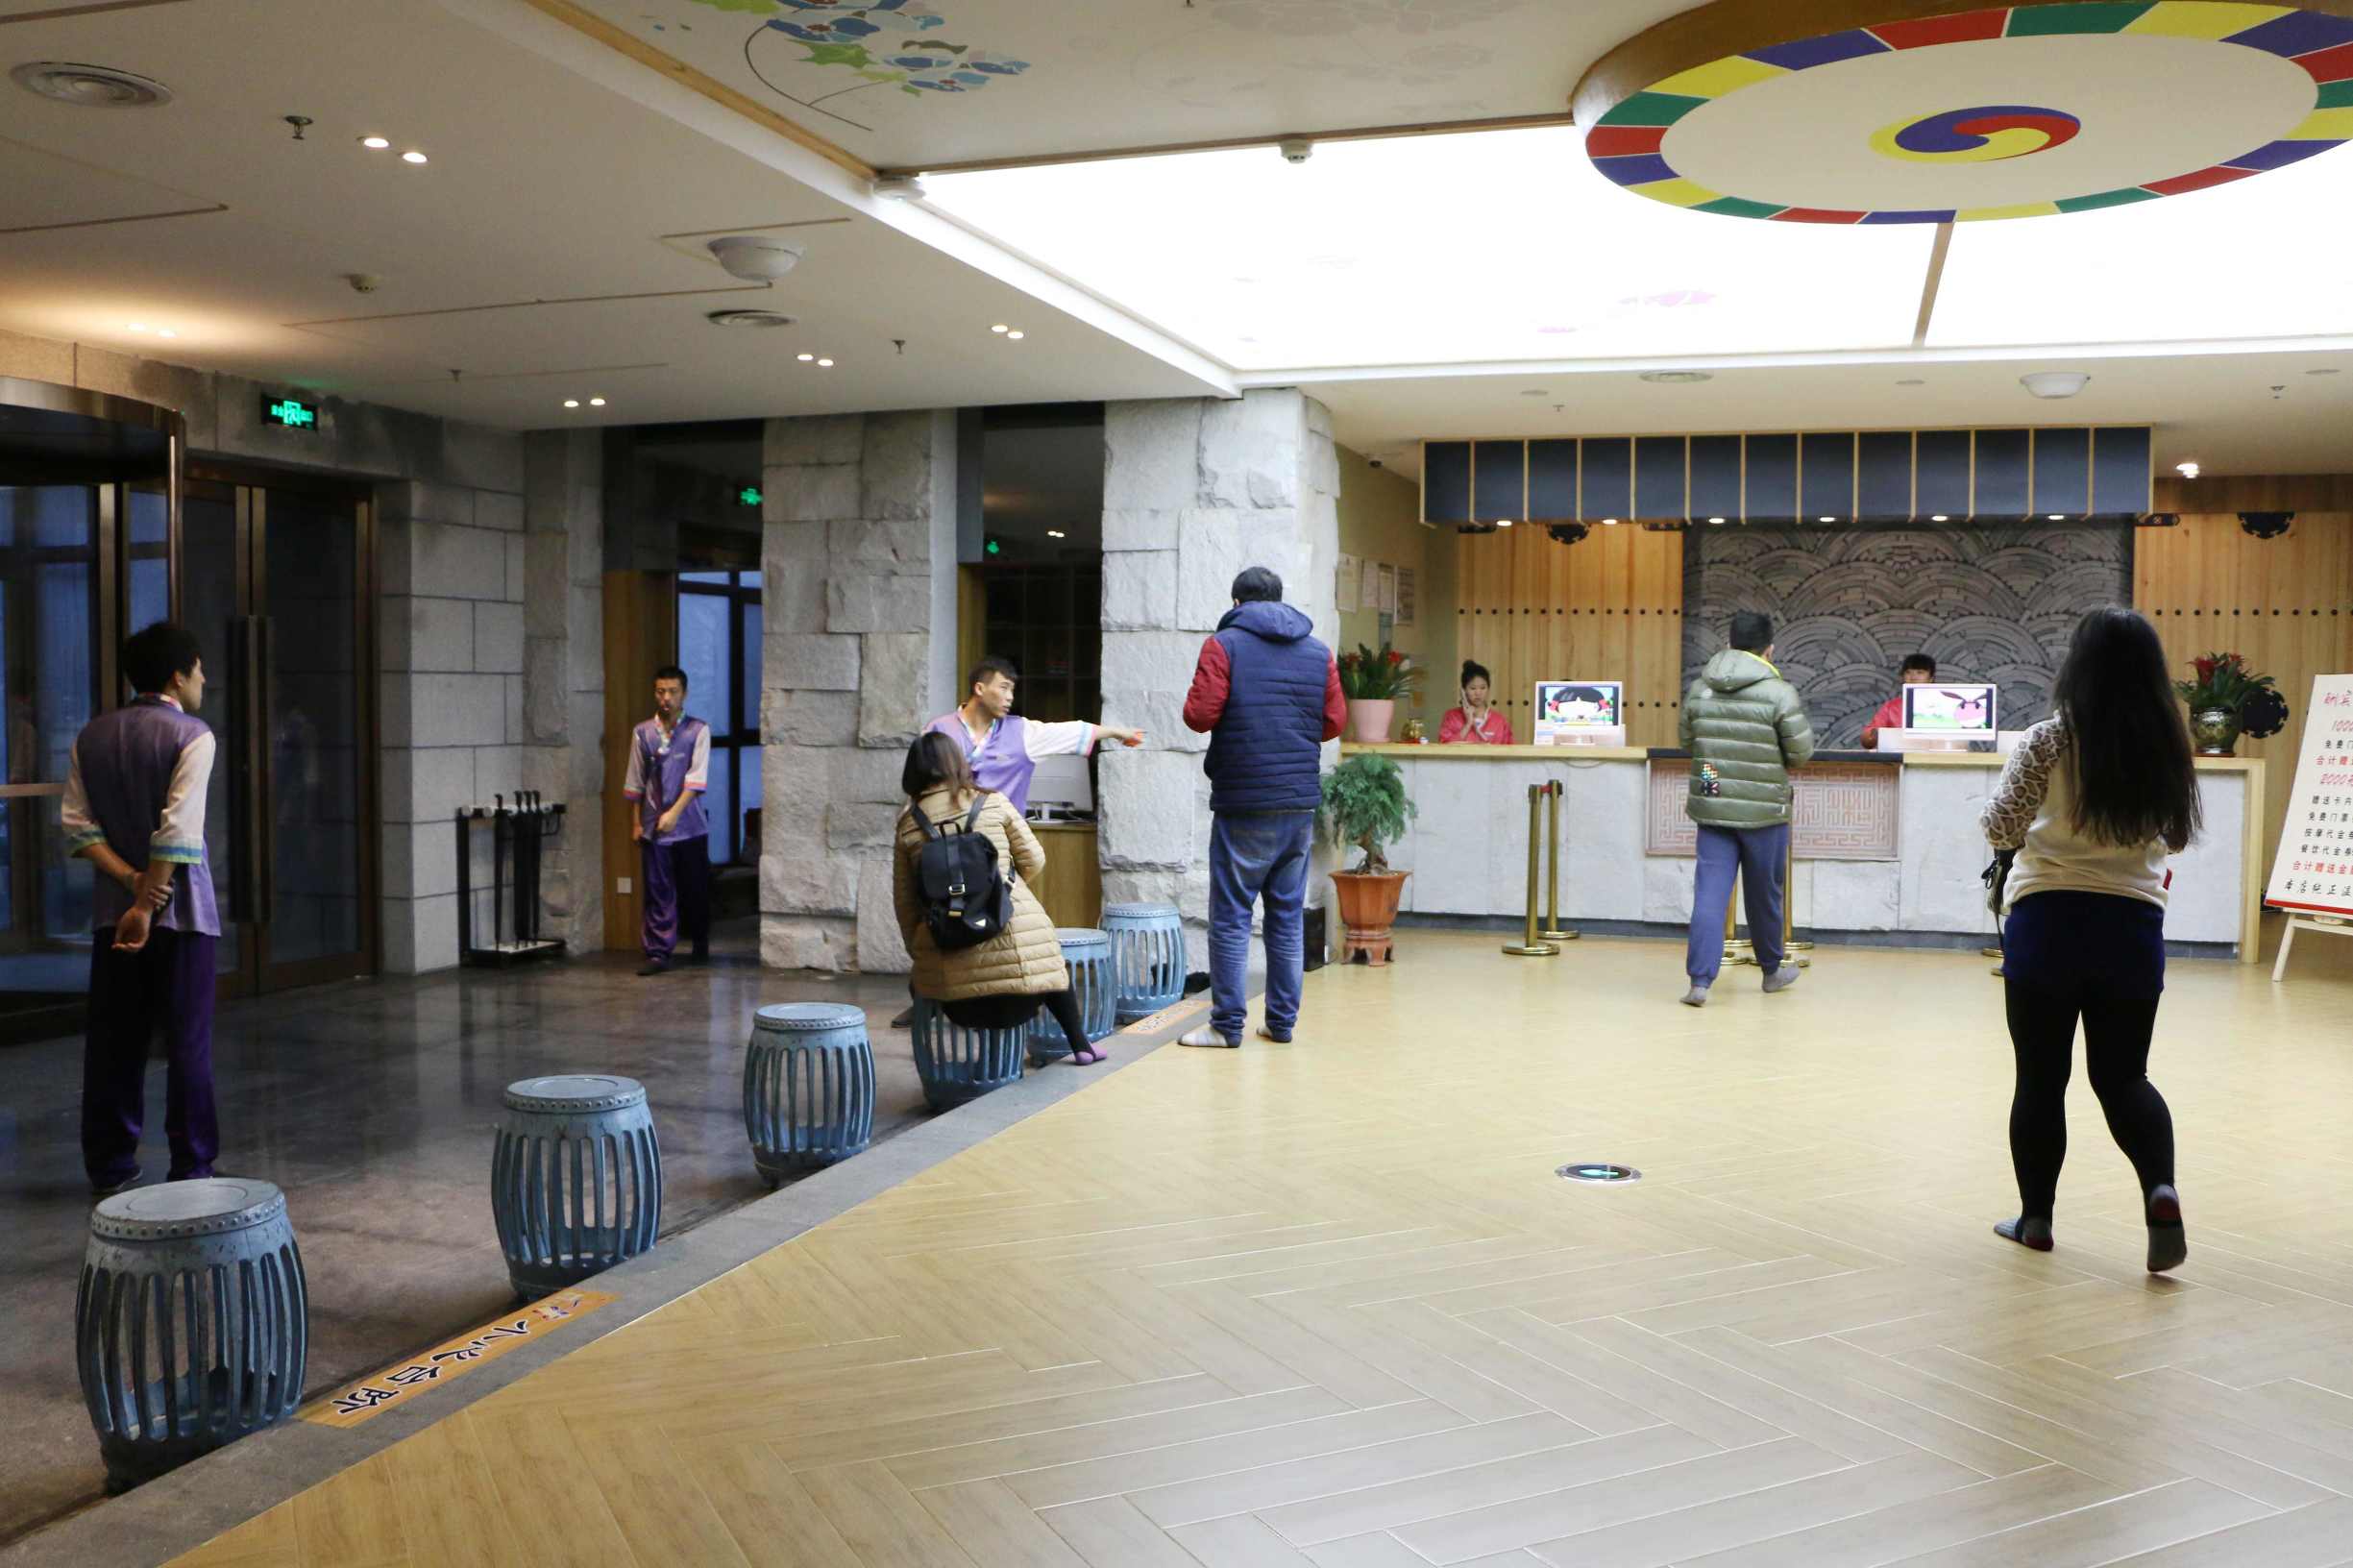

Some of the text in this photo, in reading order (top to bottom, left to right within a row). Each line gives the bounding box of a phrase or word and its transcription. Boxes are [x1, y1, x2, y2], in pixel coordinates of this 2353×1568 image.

[2316, 755, 2353, 766] 合计赠
[331, 1321, 528, 1413] 小心台阶
